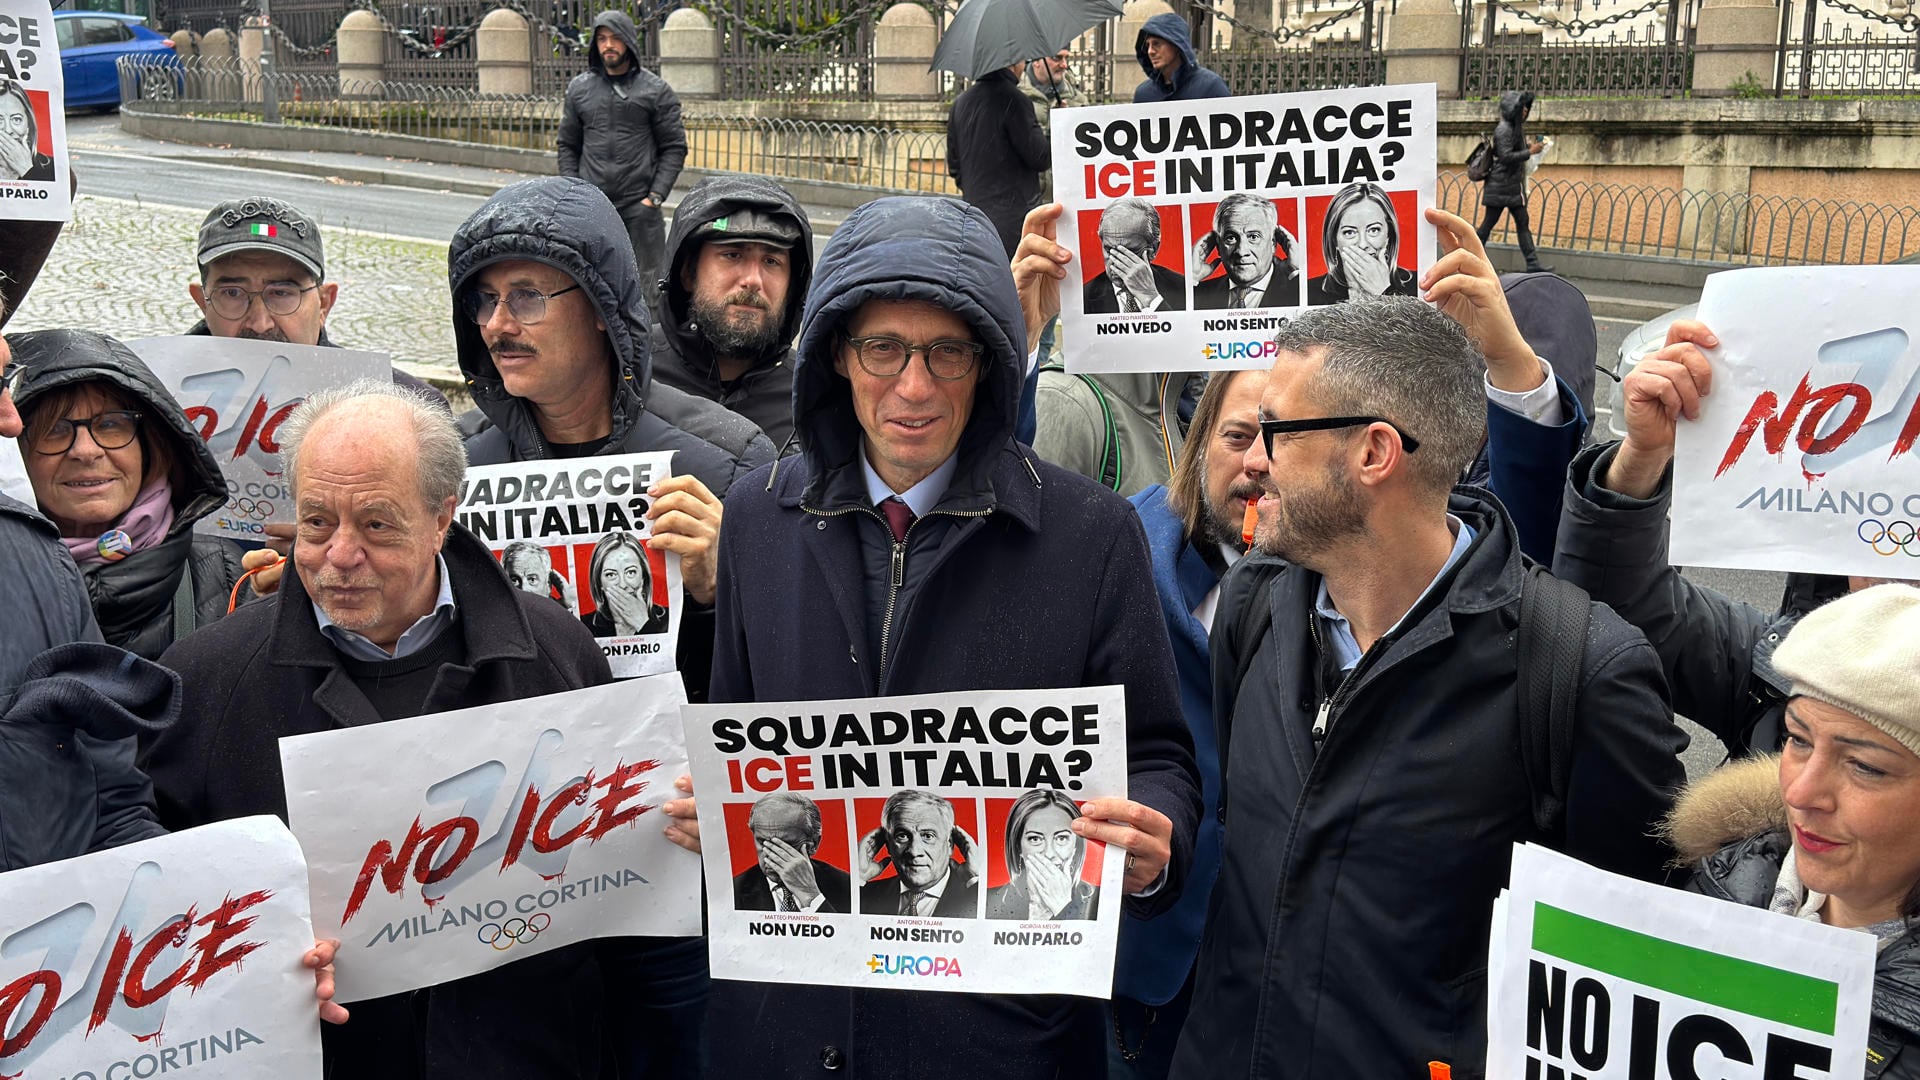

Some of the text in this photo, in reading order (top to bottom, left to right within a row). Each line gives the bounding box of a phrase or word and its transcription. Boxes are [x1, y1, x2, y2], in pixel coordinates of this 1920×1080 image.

[1074, 99, 1413, 160] SQUADRACCE
[1084, 141, 1405, 199] ICE IN ITALIA?
[6, 188, 48, 200] PARLO
[1097, 321, 1172, 335] NON VEDO
[1204, 319, 1238, 331] NON
[231, 393, 302, 461] IC
[1713, 369, 1873, 482] NO
[457, 463, 652, 508] ADRACCE
[1735, 486, 1894, 516] MILANO
[504, 497, 649, 540] ITALIA?
[602, 643, 661, 656] ON PARLO
[711, 704, 1100, 755] SQUADRACCE
[727, 749, 1093, 793] ICE IN ITALIA?
[340, 756, 665, 930] NO ICE
[366, 868, 650, 948] MILANO CORTINA
[749, 922, 835, 938] NON VEDO
[870, 926, 964, 944] NON SENTO
[994, 931, 1083, 946] NON PARLO
[0, 889, 278, 1059] O ICE
[1527, 958, 1611, 1072] NO
[106, 1027, 264, 1080] CORTINA
